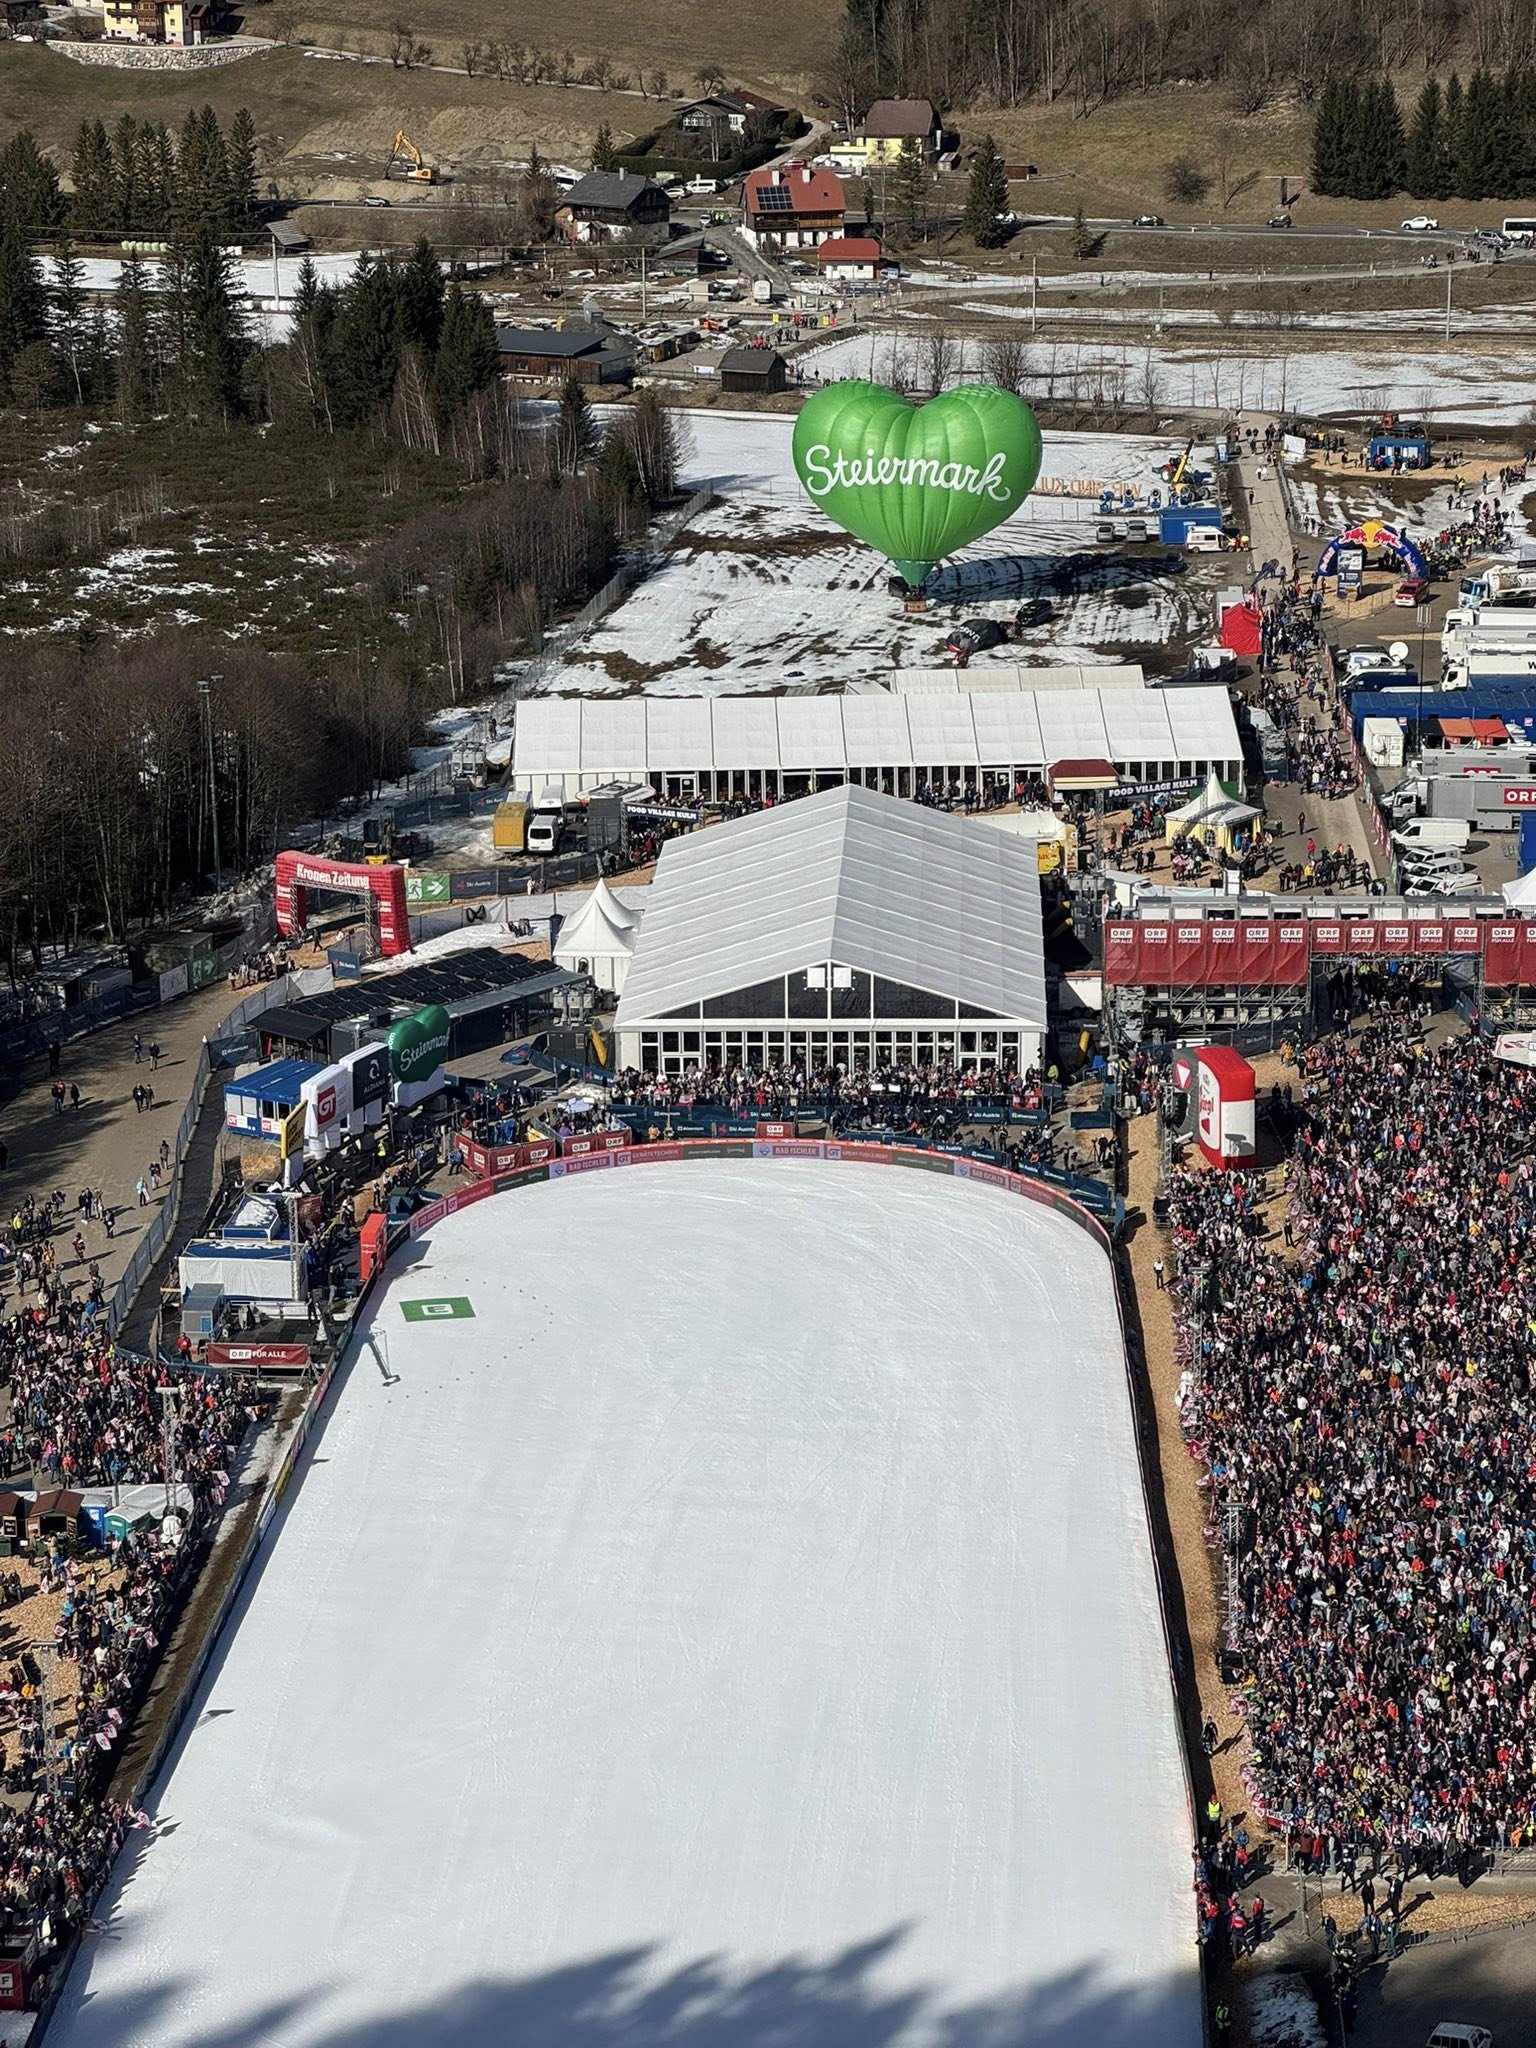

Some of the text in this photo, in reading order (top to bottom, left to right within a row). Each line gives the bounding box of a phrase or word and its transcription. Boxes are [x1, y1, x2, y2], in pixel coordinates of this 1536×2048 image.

[806, 444, 1011, 501] Steiermark
[1109, 779, 1198, 797] FOOD VILLAGE KULM
[627, 806, 697, 819] FOOD VILLAGE KULM
[296, 863, 370, 890] Kronen Zeitung
[319, 1093, 335, 1116] GT
[573, 1144, 590, 1152] ORF
[828, 1148, 840, 1157] GT
[569, 1158, 608, 1171] BAD ISCHLER
[252, 1350, 266, 1358] FÜR
